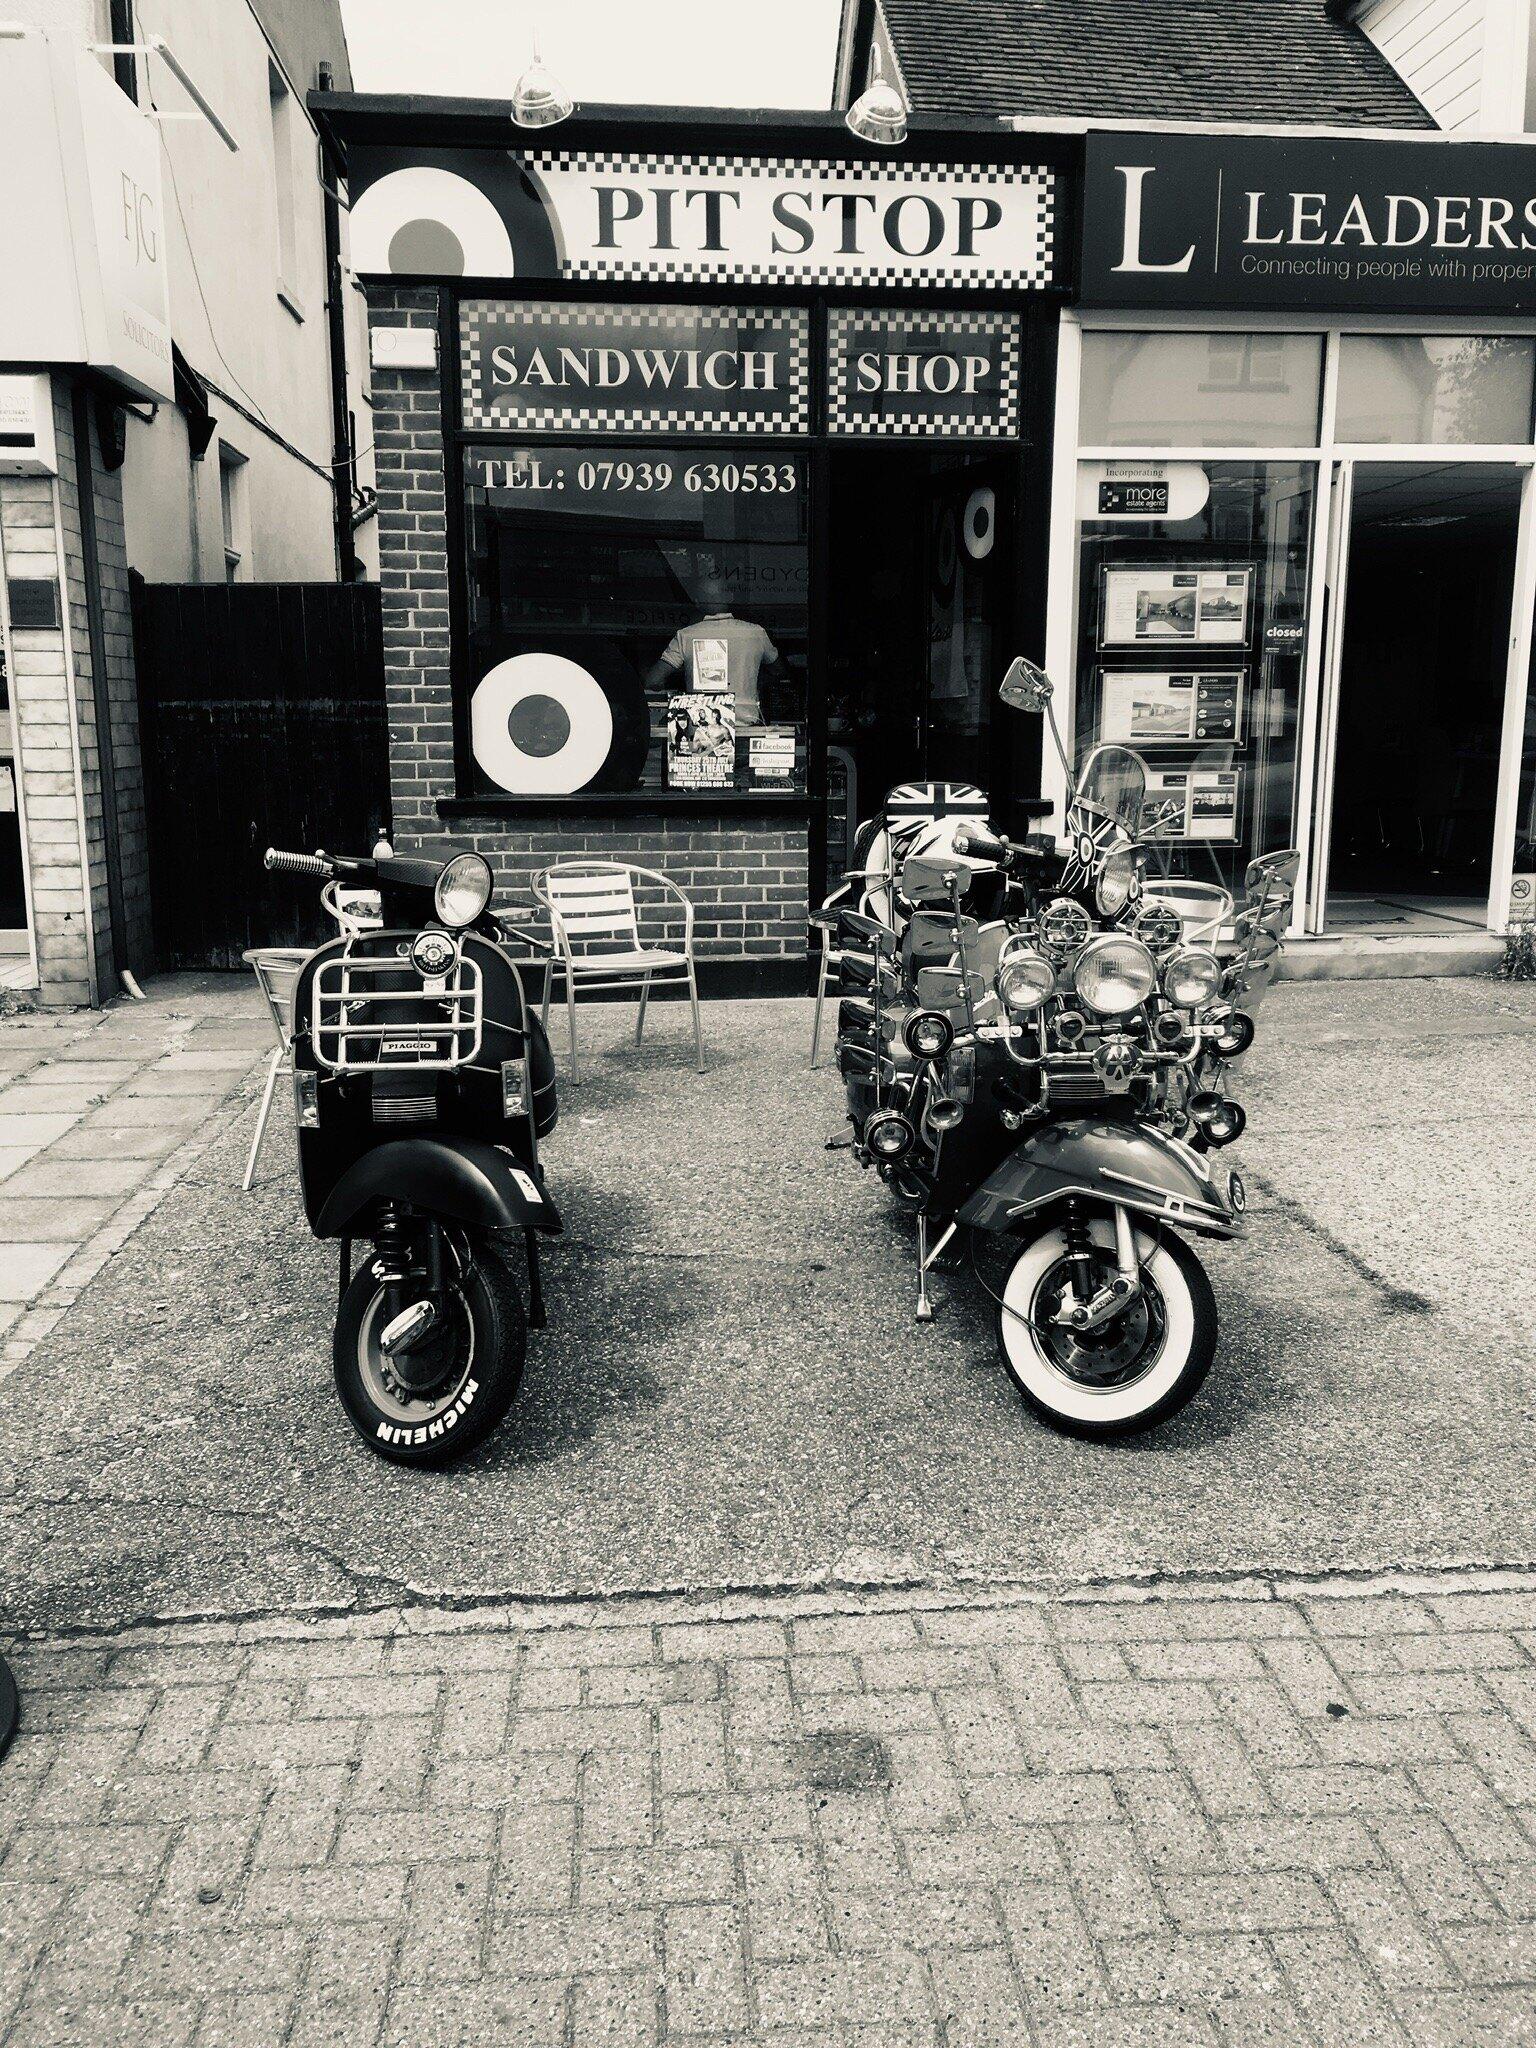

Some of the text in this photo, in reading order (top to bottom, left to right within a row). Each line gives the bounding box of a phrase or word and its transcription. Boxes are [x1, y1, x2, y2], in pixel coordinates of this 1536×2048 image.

[589, 187, 1002, 257] PIT STOP
[1110, 166, 1196, 273] L
[1241, 254, 1536, 283] Connecting people with proper
[491, 345, 991, 394] SANDWICH SHOP
[477, 460, 796, 493] TEL: 07939 630533
[1106, 468, 1163, 478] Incorporating
[1126, 488, 1166, 500] more
[1146, 500, 1166, 508] agents
[1266, 626, 1303, 637] closed
[668, 693, 735, 709] WRESTLING
[669, 763, 734, 773] PRINCES THEATRE
[376, 1378, 479, 1446] MICHELIN
